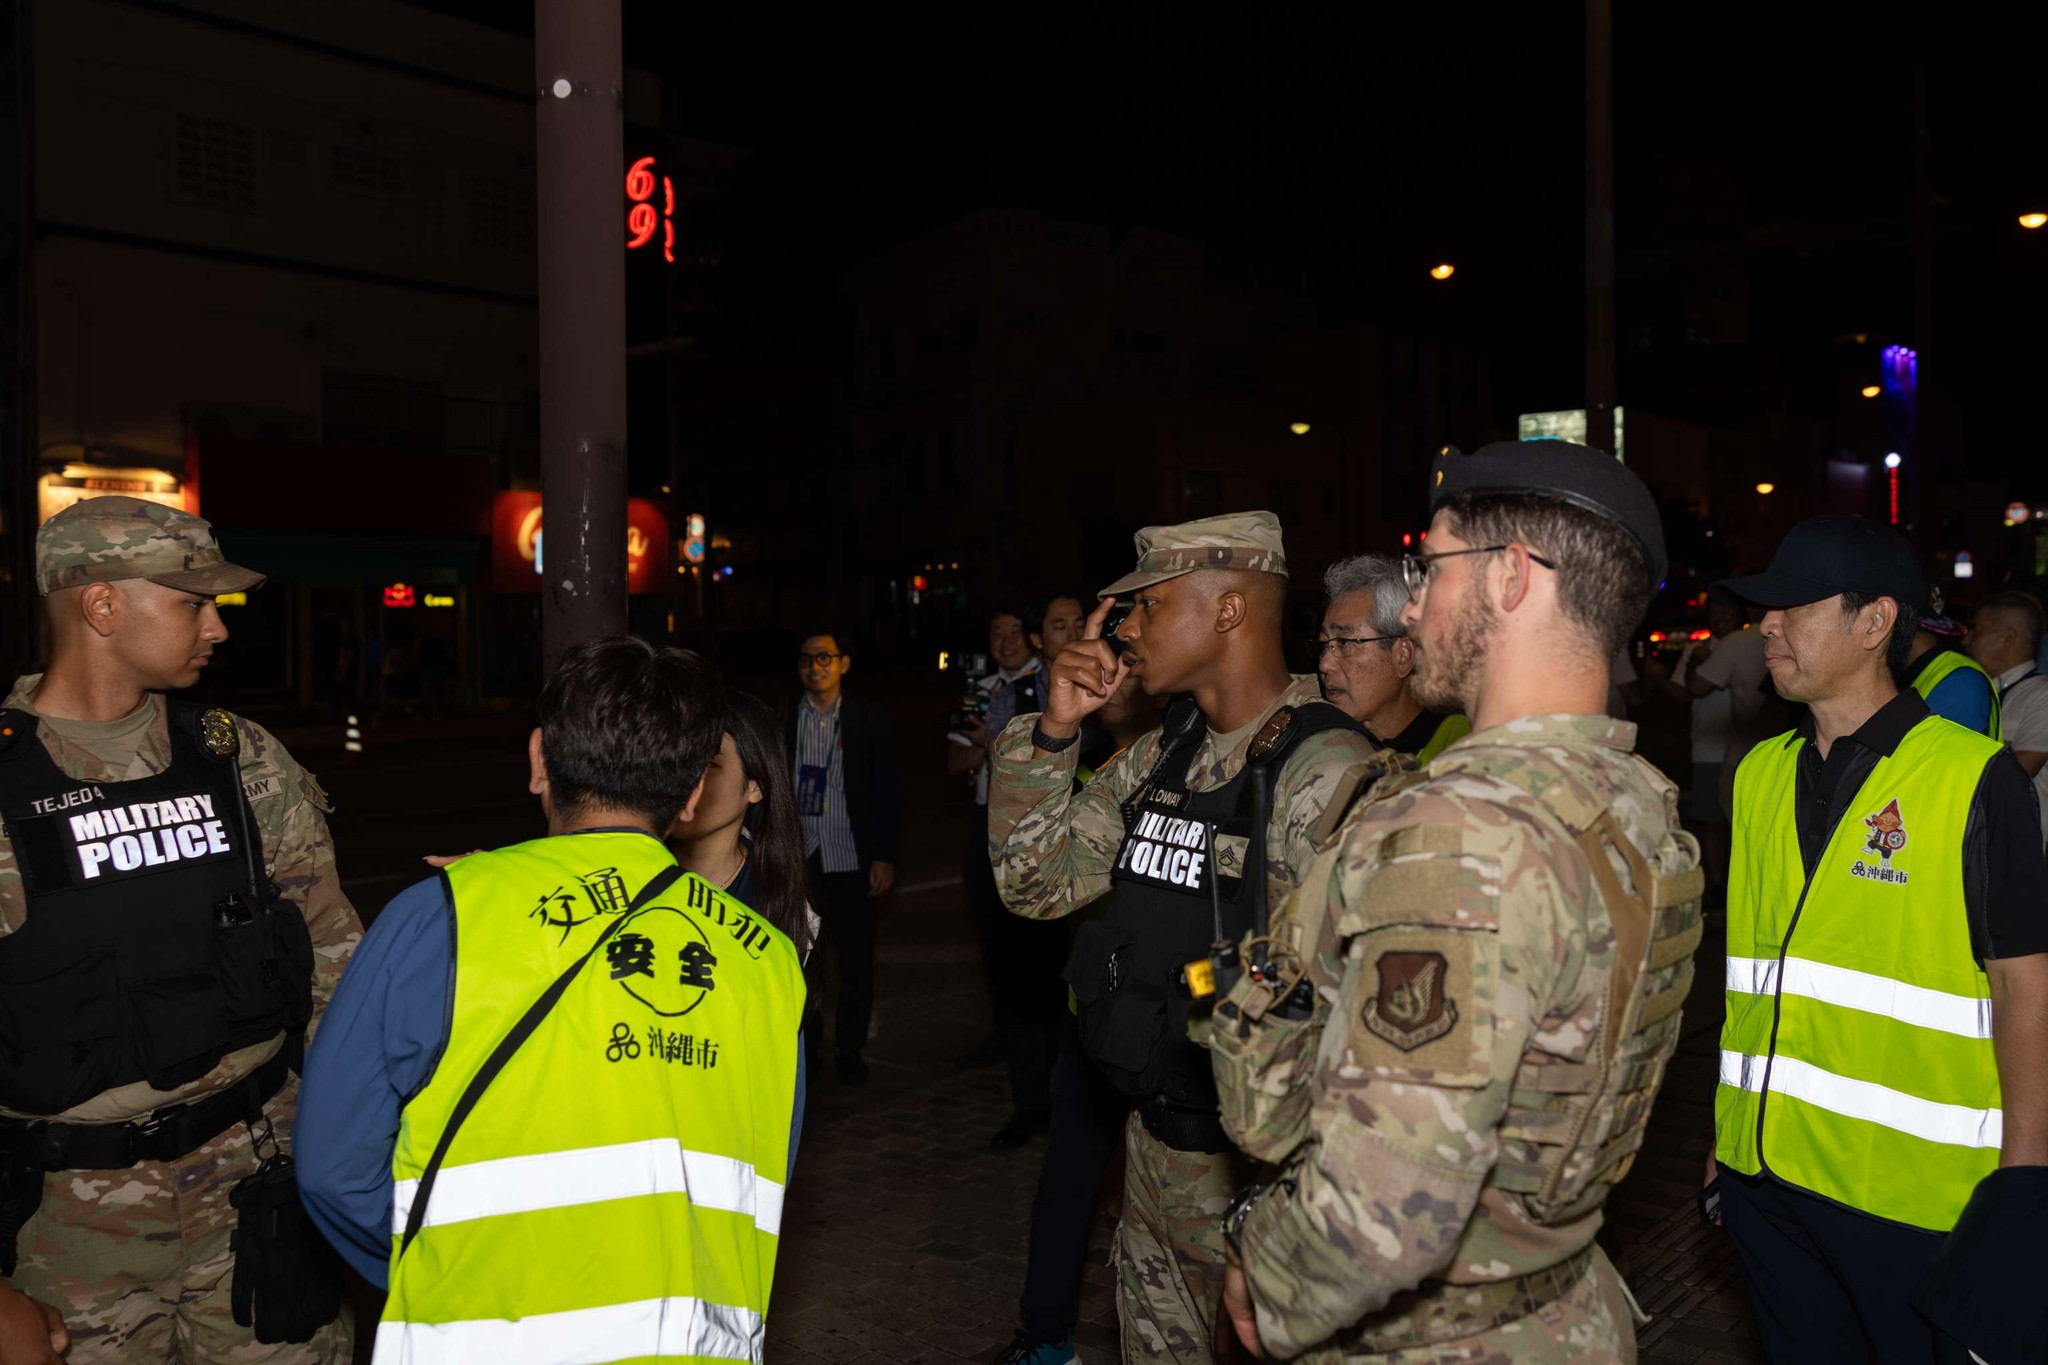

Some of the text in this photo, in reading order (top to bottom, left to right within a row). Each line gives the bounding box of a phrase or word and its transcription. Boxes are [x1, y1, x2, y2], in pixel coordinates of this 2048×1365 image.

[31, 786, 106, 814] TEJEDA
[68, 794, 216, 842] MILITARY
[77, 820, 230, 880] POLICE
[1118, 838, 1206, 889] POLICE
[529, 867, 771, 960] 交通 防犯
[606, 933, 718, 992] 安全
[647, 1025, 720, 1070] 沖縄市
